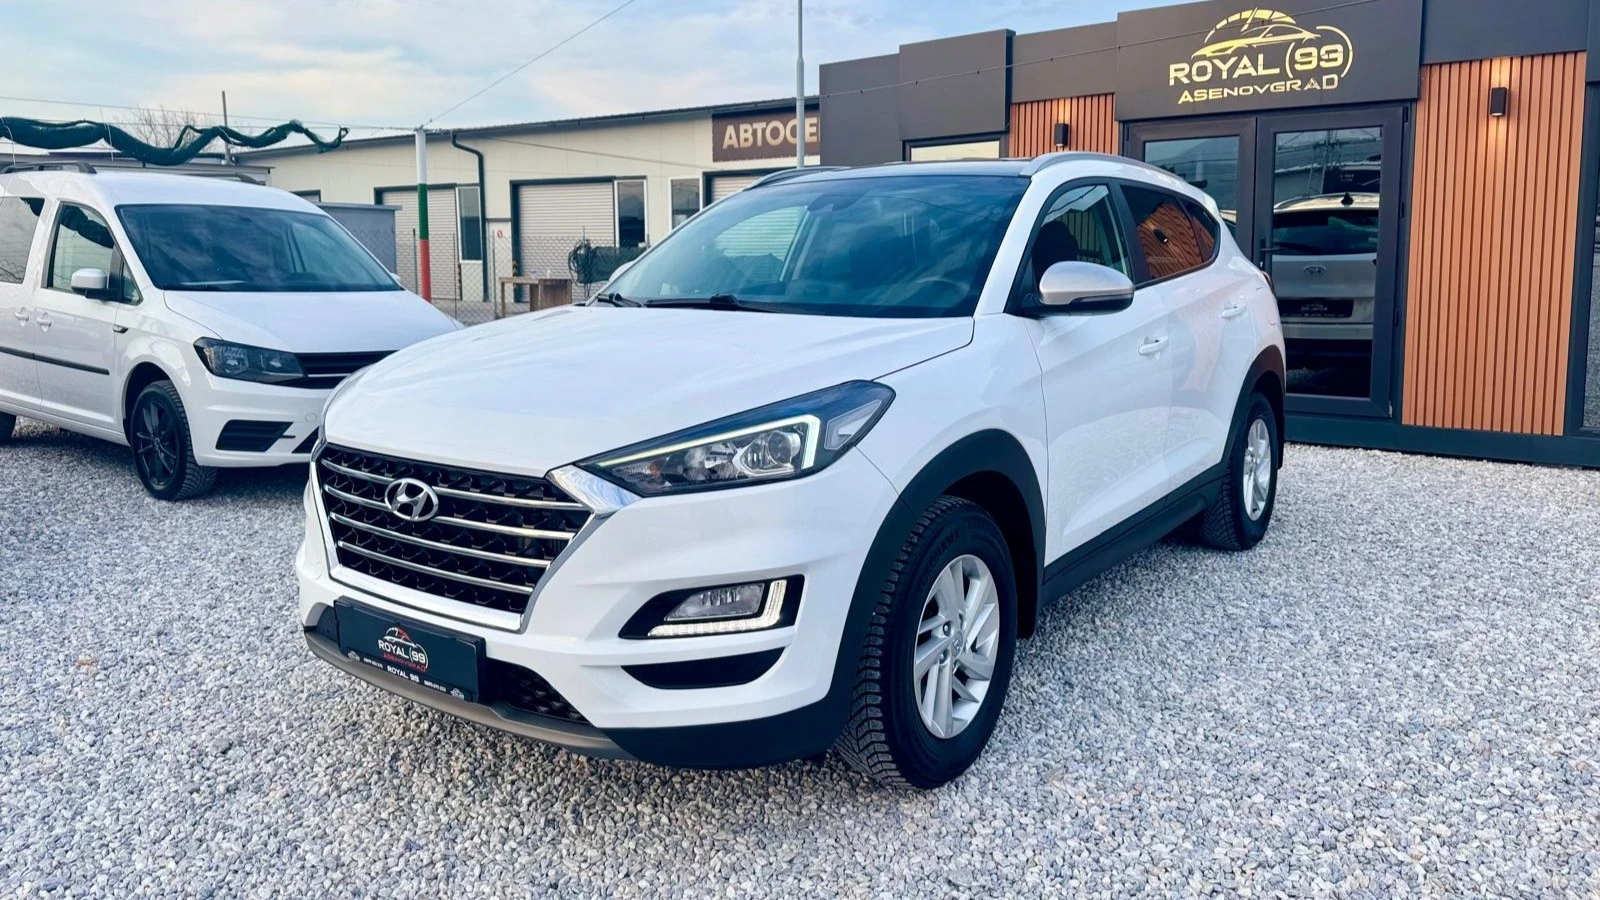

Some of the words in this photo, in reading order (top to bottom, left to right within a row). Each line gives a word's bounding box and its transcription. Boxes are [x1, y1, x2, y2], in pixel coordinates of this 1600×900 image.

[1169, 54, 1280, 86] ROYAL
[1177, 73, 1338, 104] ASENOVGRAD
[722, 117, 820, 149] АВТОСЕ
[378, 640, 410, 658] ROYAL
[387, 666, 409, 678] ROYAL
